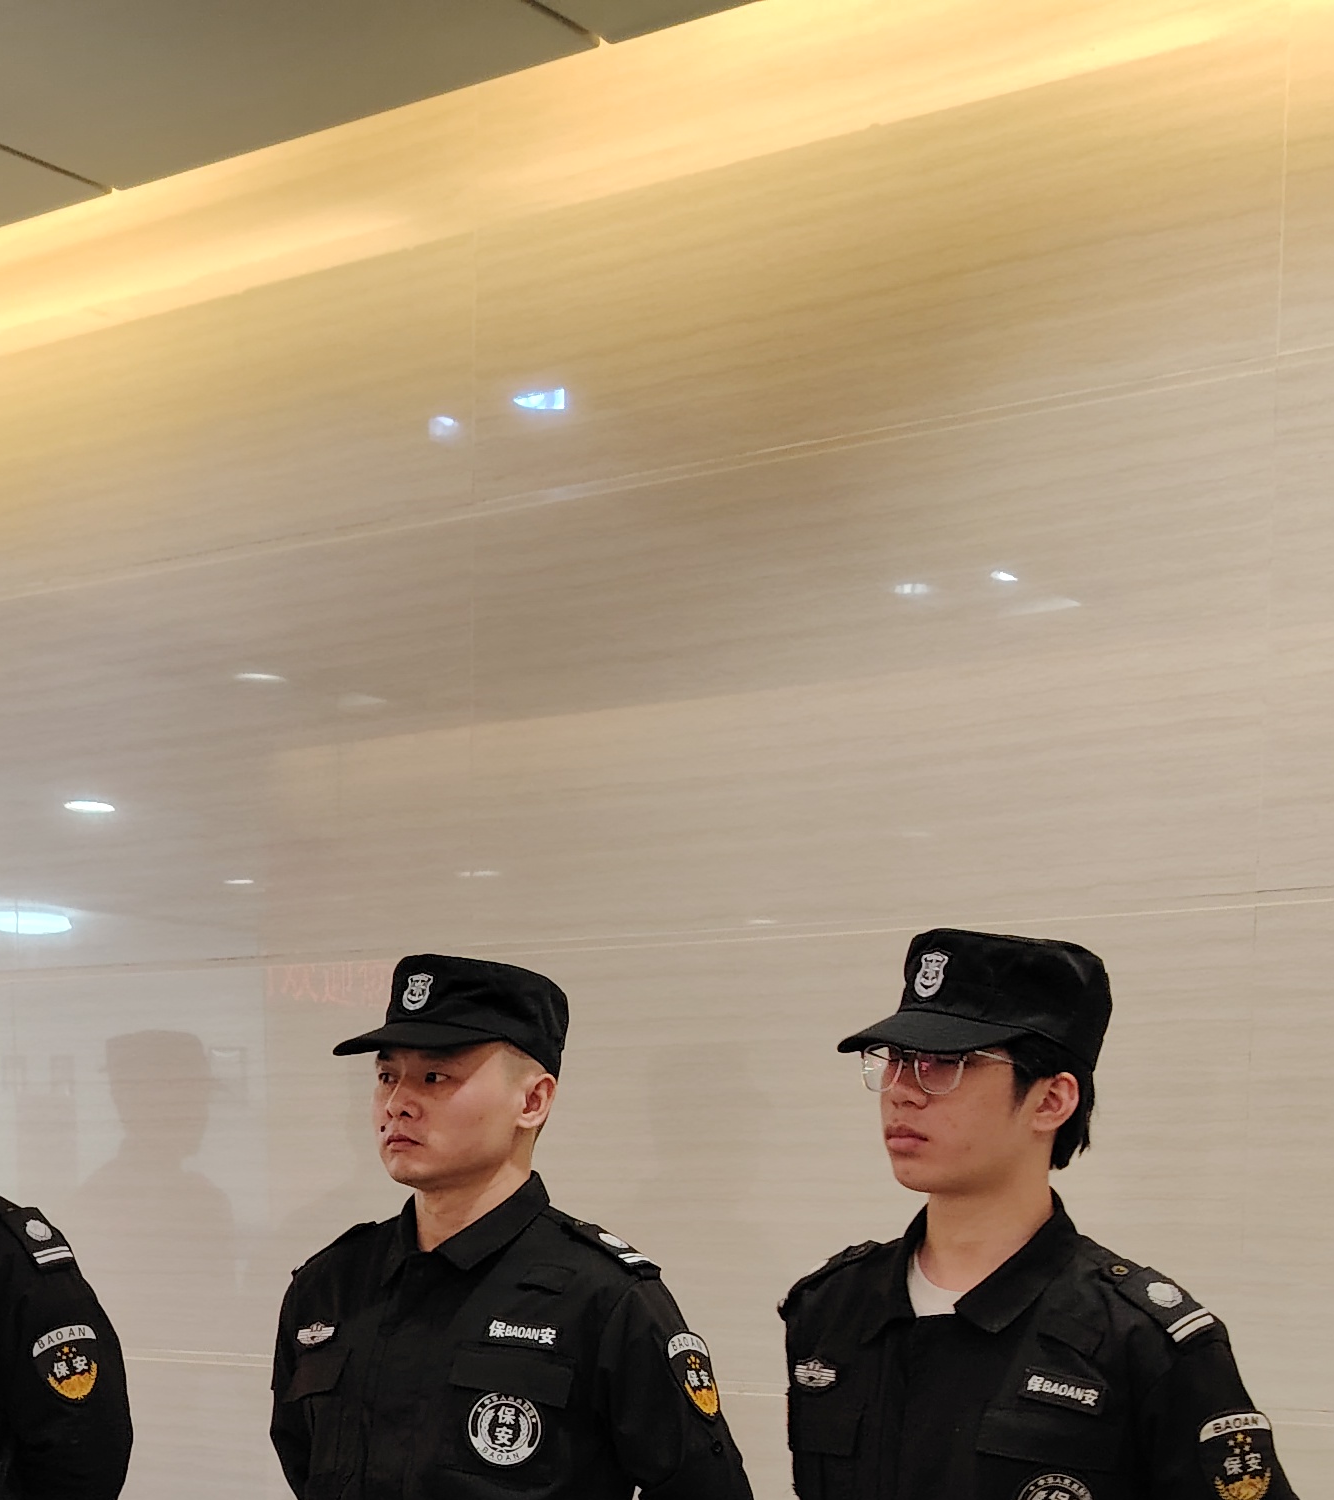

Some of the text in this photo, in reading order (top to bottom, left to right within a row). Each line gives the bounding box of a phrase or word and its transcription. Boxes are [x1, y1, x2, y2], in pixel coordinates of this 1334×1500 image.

[37, 1326, 87, 1350] BAOAN
[53, 1355, 89, 1379] 保安
[686, 1369, 712, 1388] 保安
[495, 1405, 516, 1446] 保安
[1212, 1416, 1260, 1434] BAOAN
[482, 1447, 520, 1462] BAOAN
[1223, 1452, 1262, 1476] 保安
